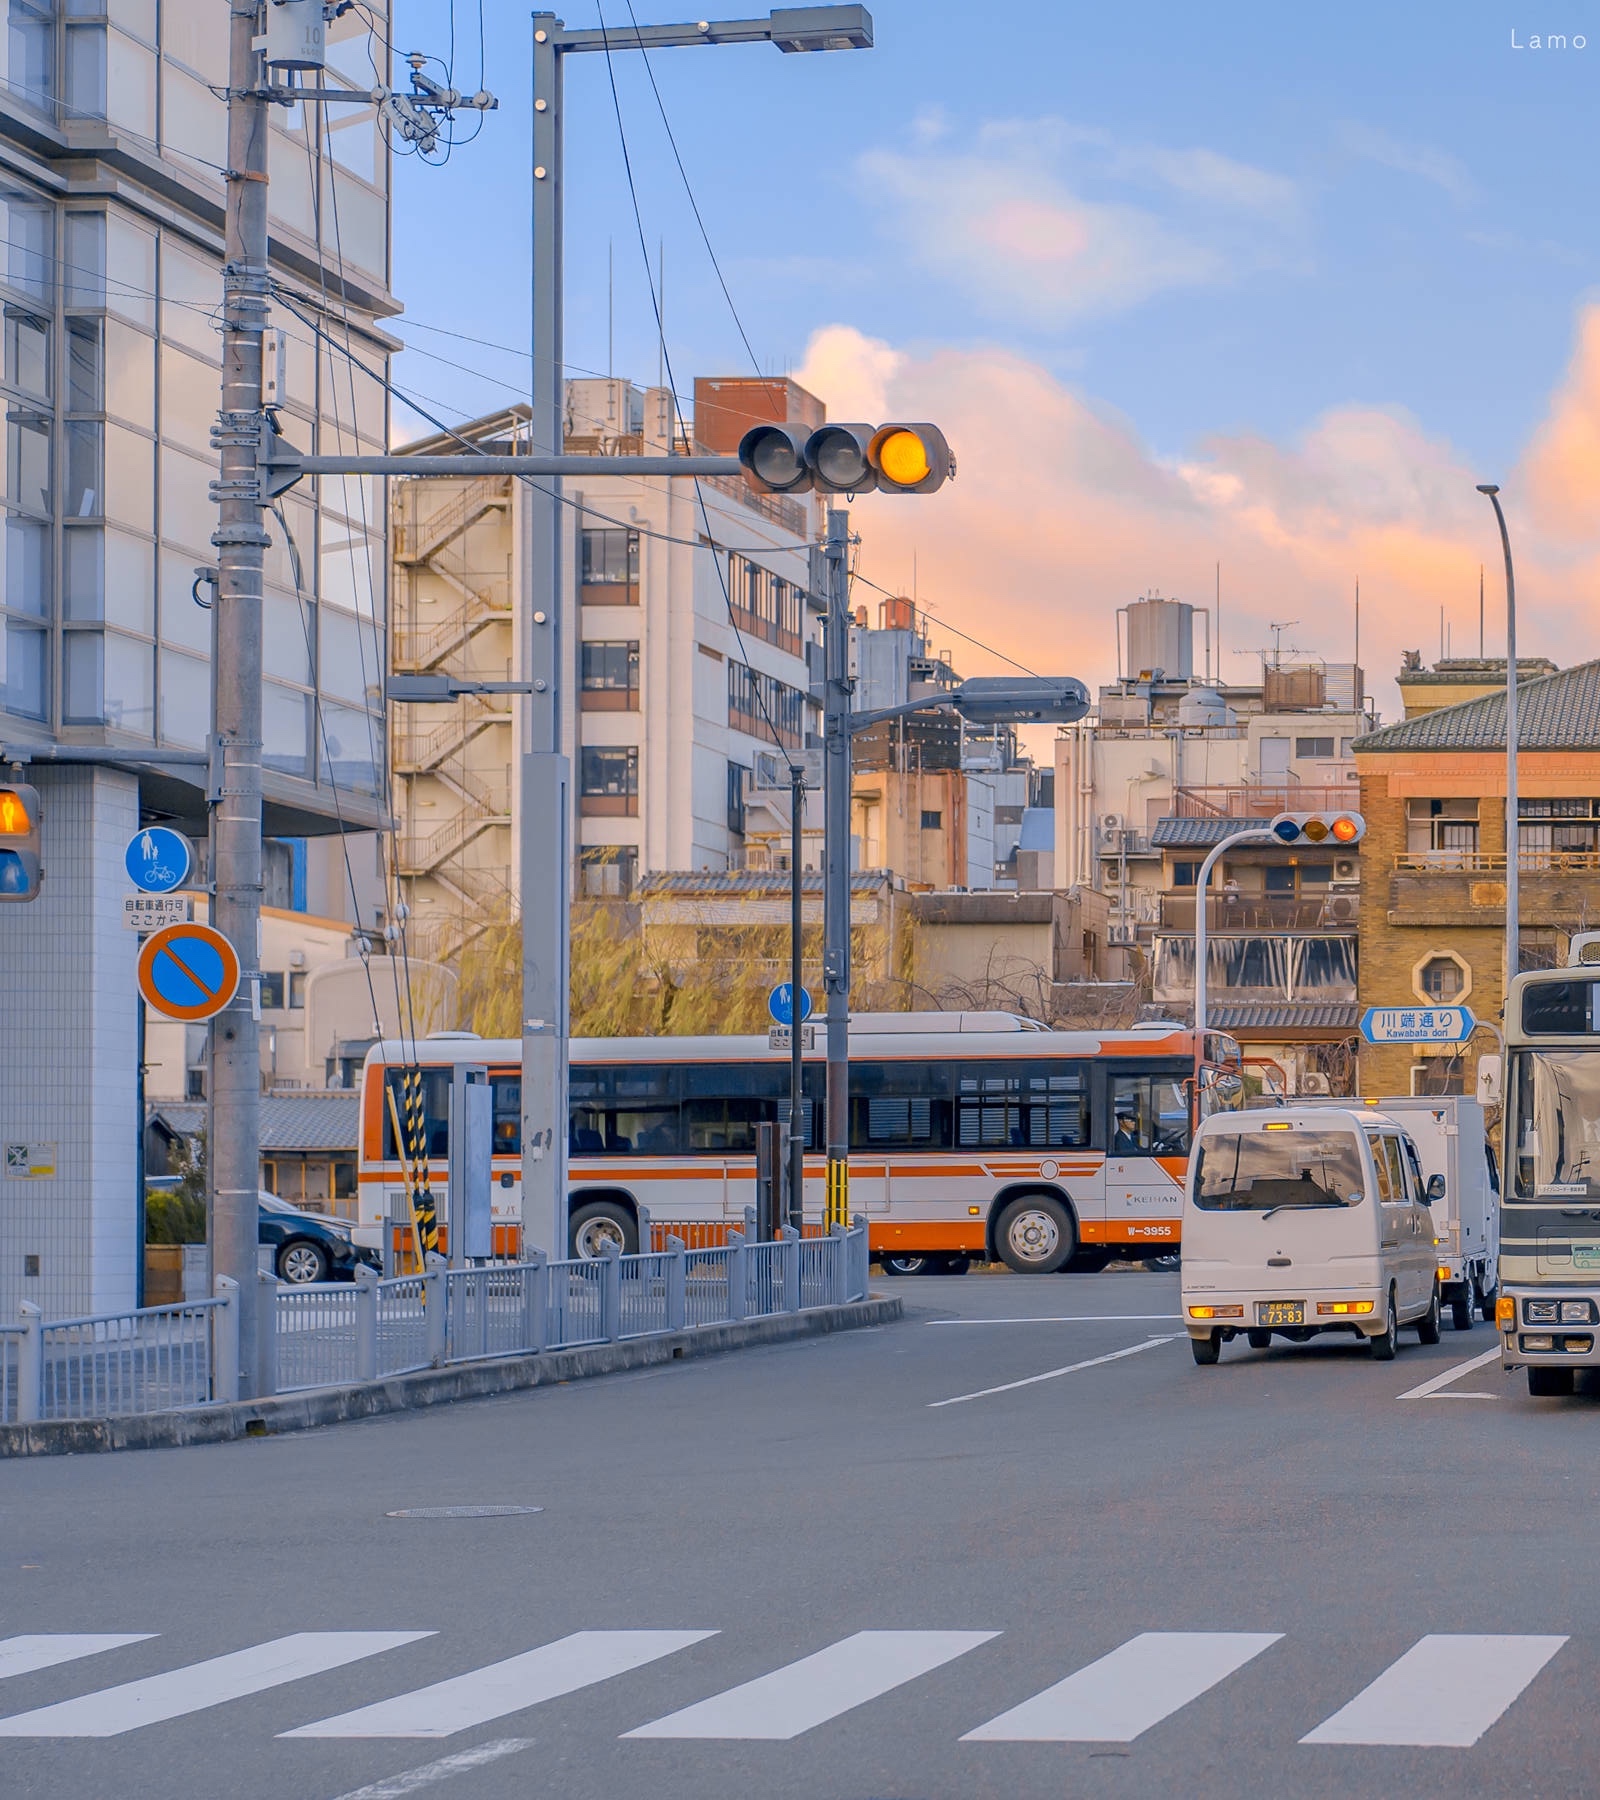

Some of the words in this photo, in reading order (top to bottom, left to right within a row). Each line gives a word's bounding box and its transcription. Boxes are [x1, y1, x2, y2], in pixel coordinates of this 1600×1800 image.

[125, 900, 184, 911] 自転車通行可
[130, 915, 179, 926] ここから
[1381, 1012, 1453, 1028] 川端通り
[1386, 1029, 1428, 1037] Kawabata
[1432, 1028, 1448, 1037] dori
[1127, 1226, 1171, 1236] W-3955
[1268, 1310, 1302, 1323] 73-83
